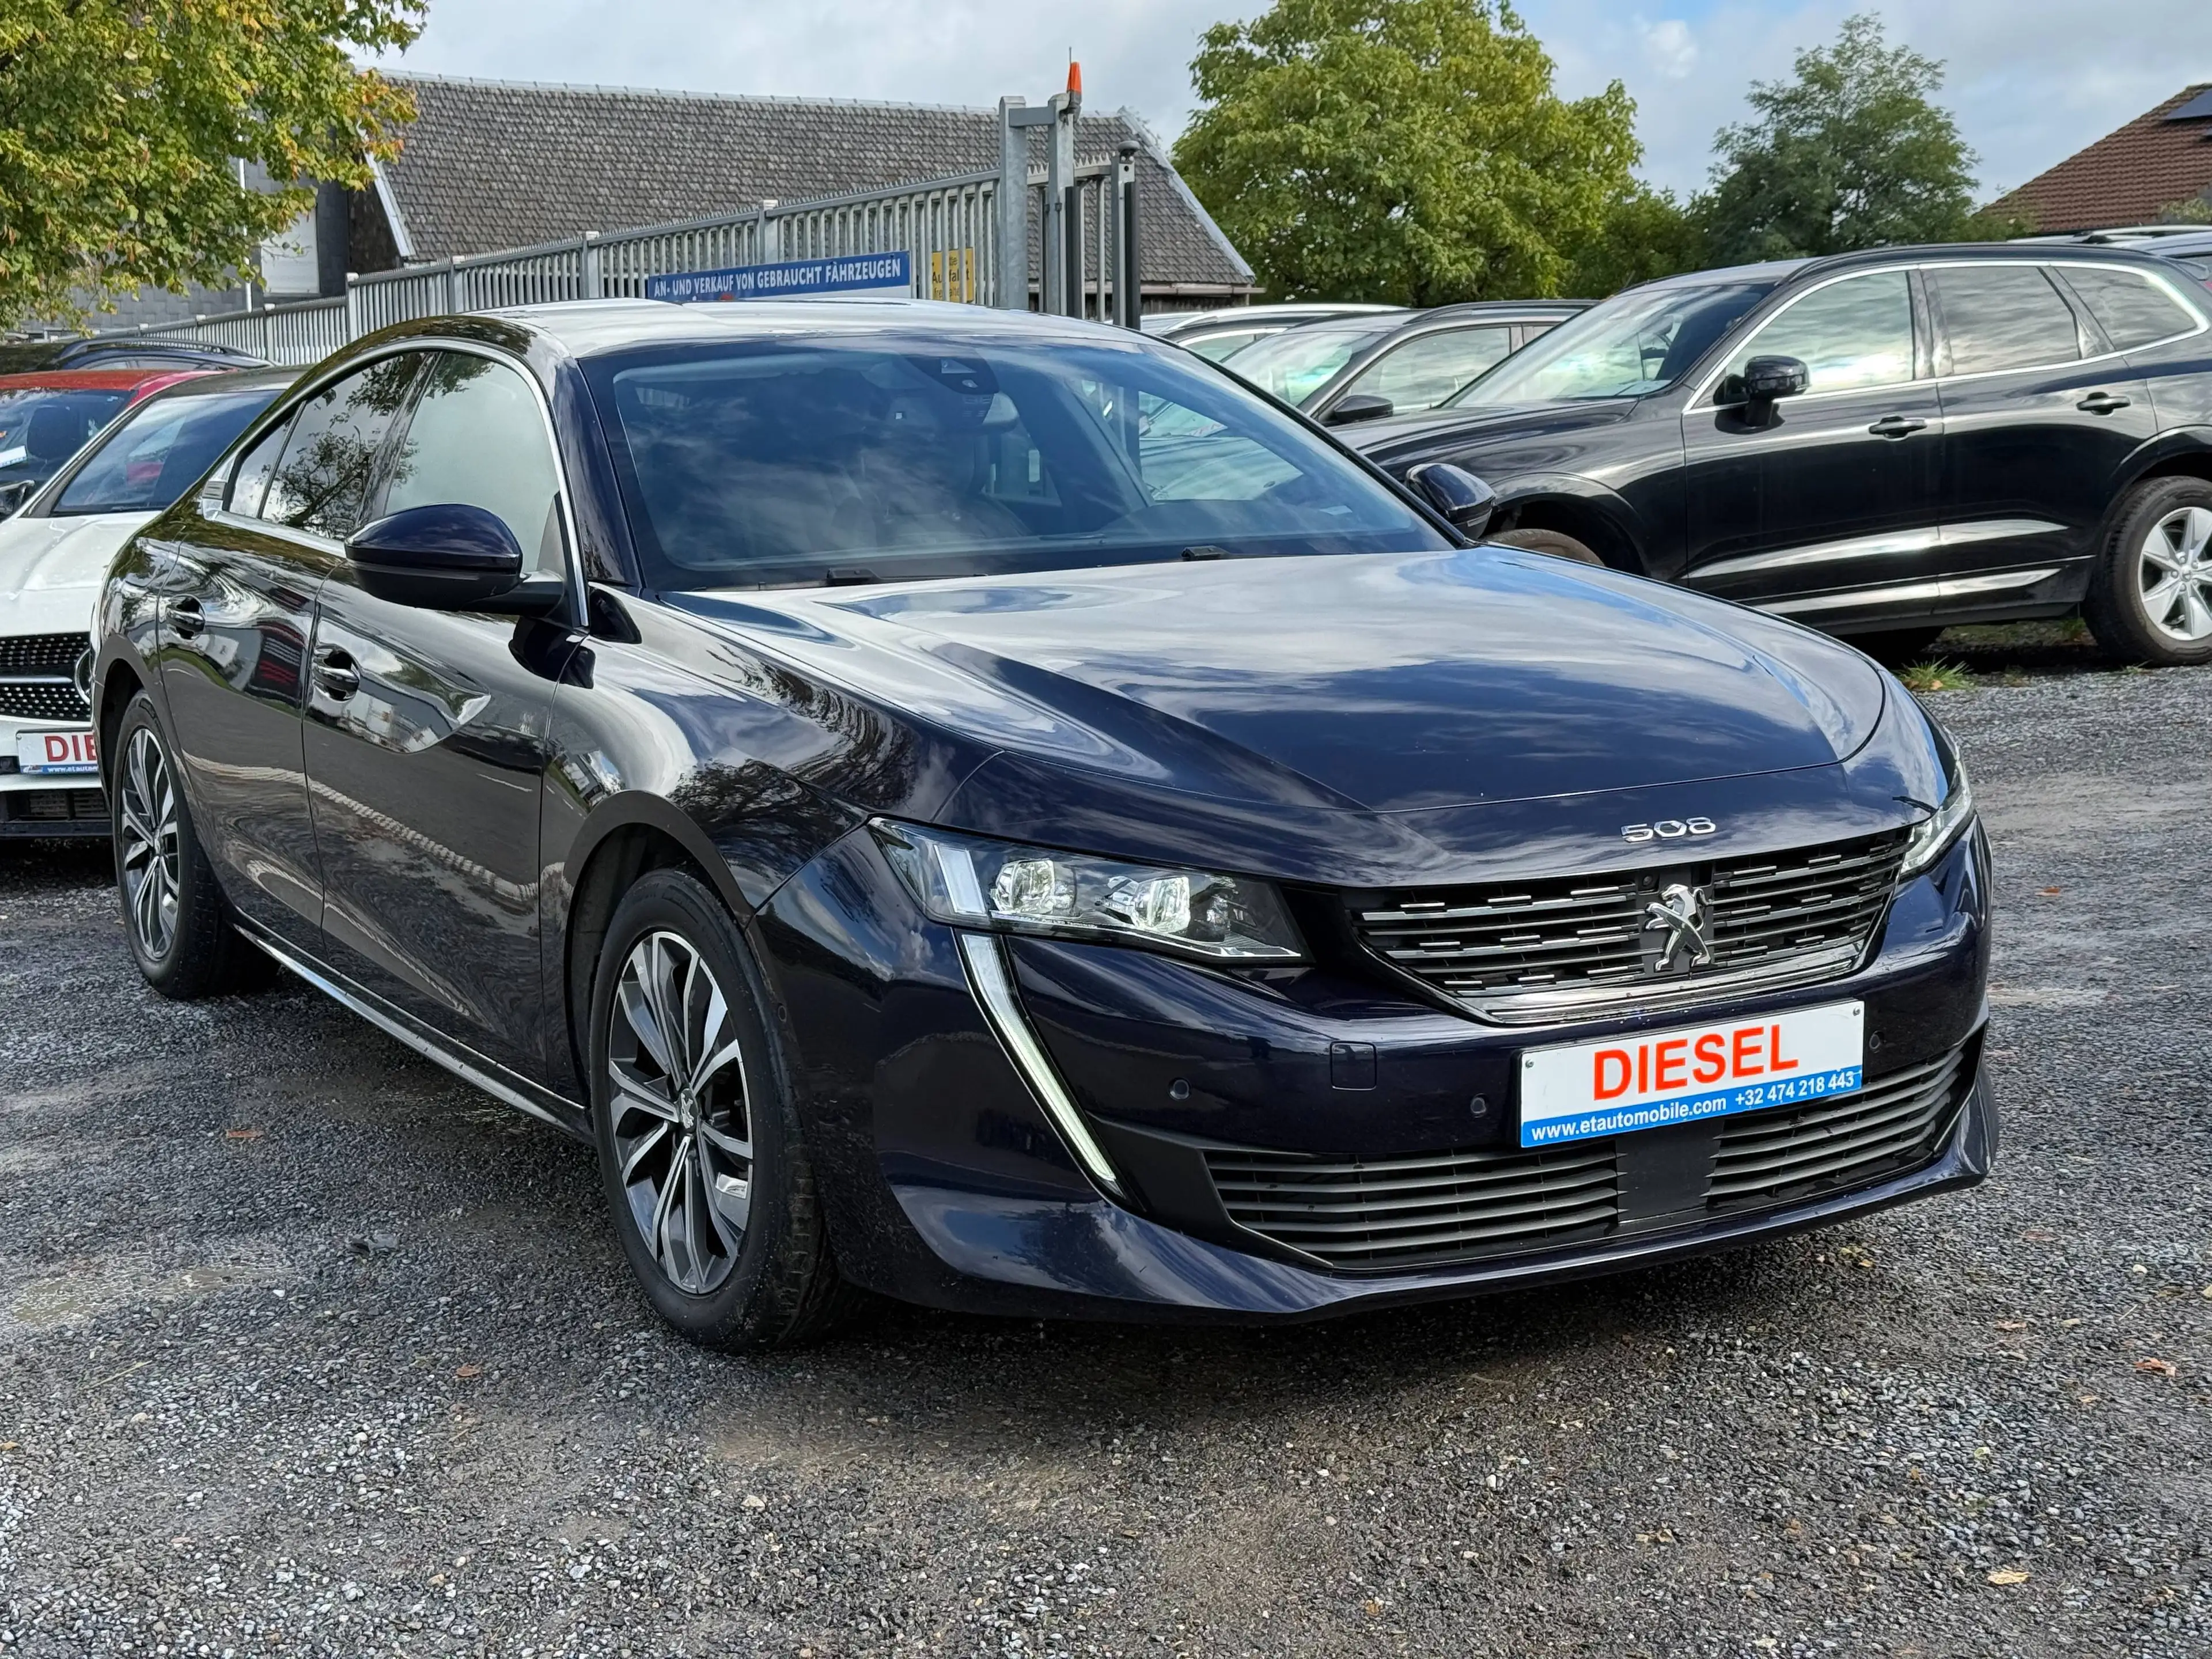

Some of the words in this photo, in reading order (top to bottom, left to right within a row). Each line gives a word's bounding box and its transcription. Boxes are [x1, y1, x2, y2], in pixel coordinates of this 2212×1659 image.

[654, 279, 670, 297] AN-
[673, 278, 692, 296] UND
[694, 274, 734, 294] VERKAUF
[736, 271, 755, 290] VON
[757, 266, 822, 289] GEBRAUCHT
[44, 734, 97, 762] DIE
[1620, 816, 1717, 843] 508
[1593, 1024, 1798, 1101] DIESEL
[1531, 1097, 1726, 1141] www.etautomobile.com
[1734, 1087, 1764, 1107] +32
[1767, 1083, 1795, 1102] 474
[1798, 1077, 1825, 1097] 218
[1828, 1073, 1854, 1092] 443
